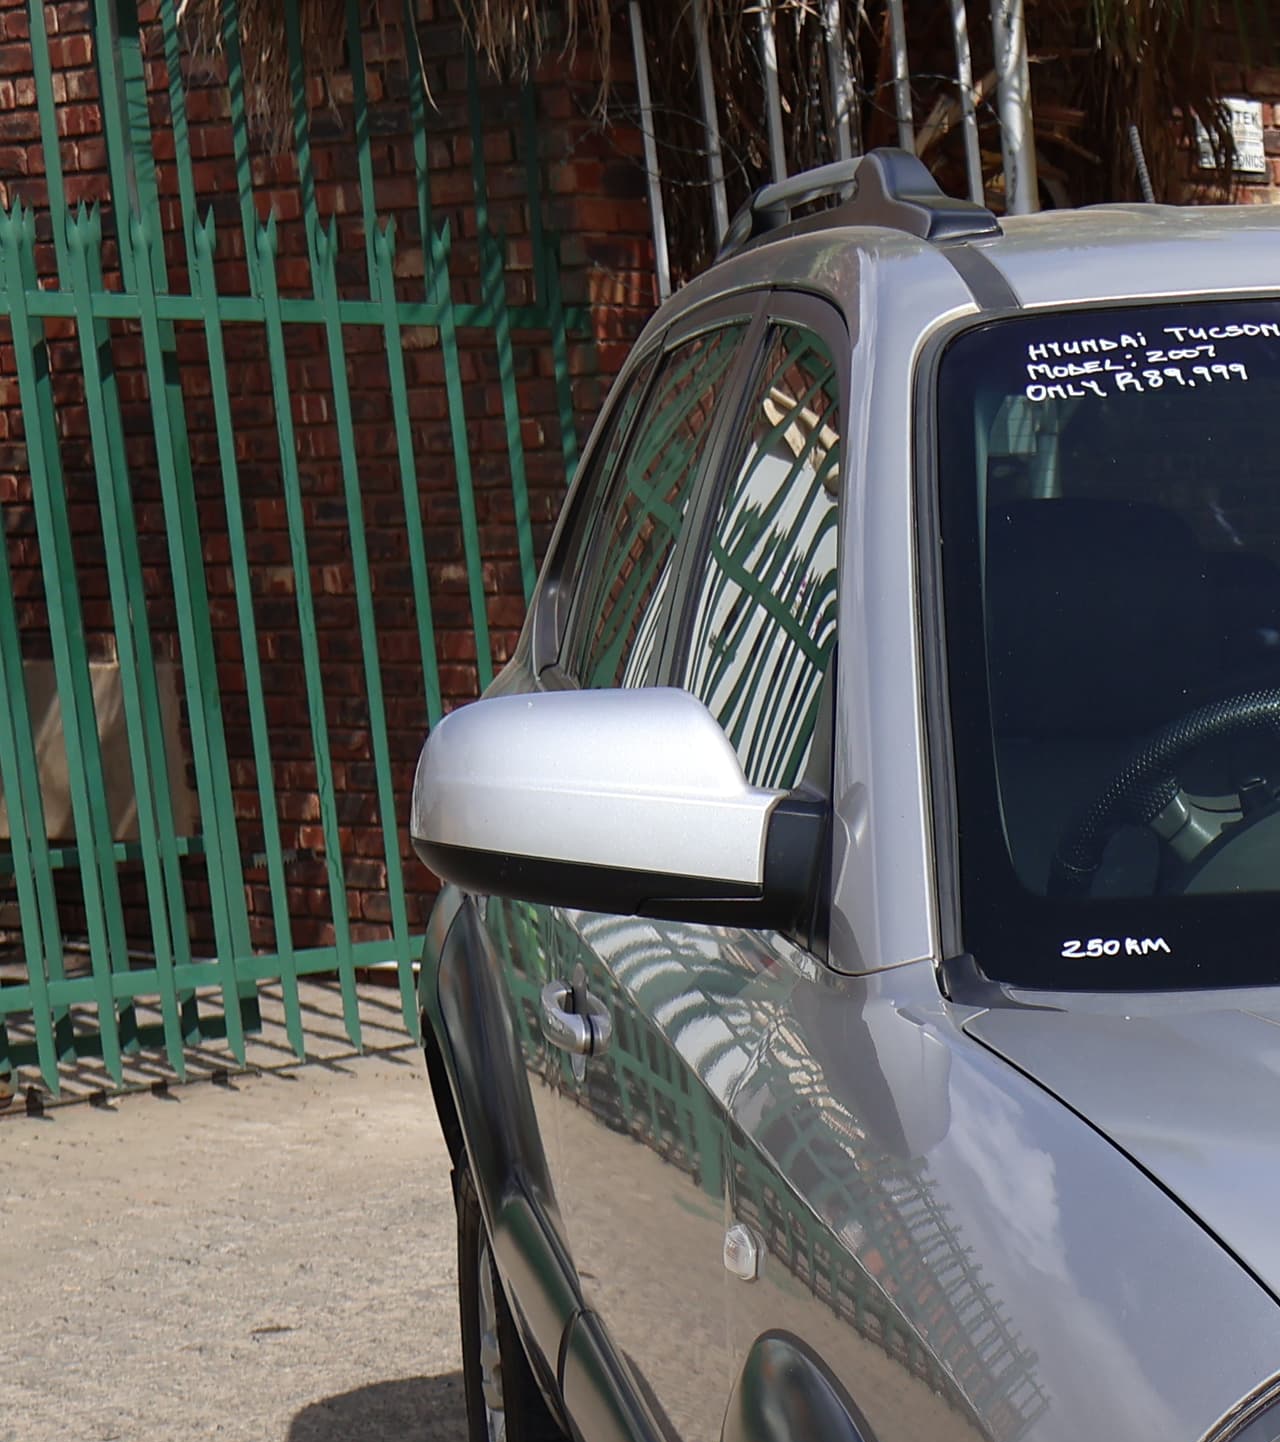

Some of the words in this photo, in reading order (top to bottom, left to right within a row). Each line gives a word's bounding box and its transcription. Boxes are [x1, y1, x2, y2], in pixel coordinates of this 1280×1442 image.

[1145, 345, 1216, 363] 2007
[1025, 380, 1107, 402] ONLY
[1061, 938, 1121, 958] 250
